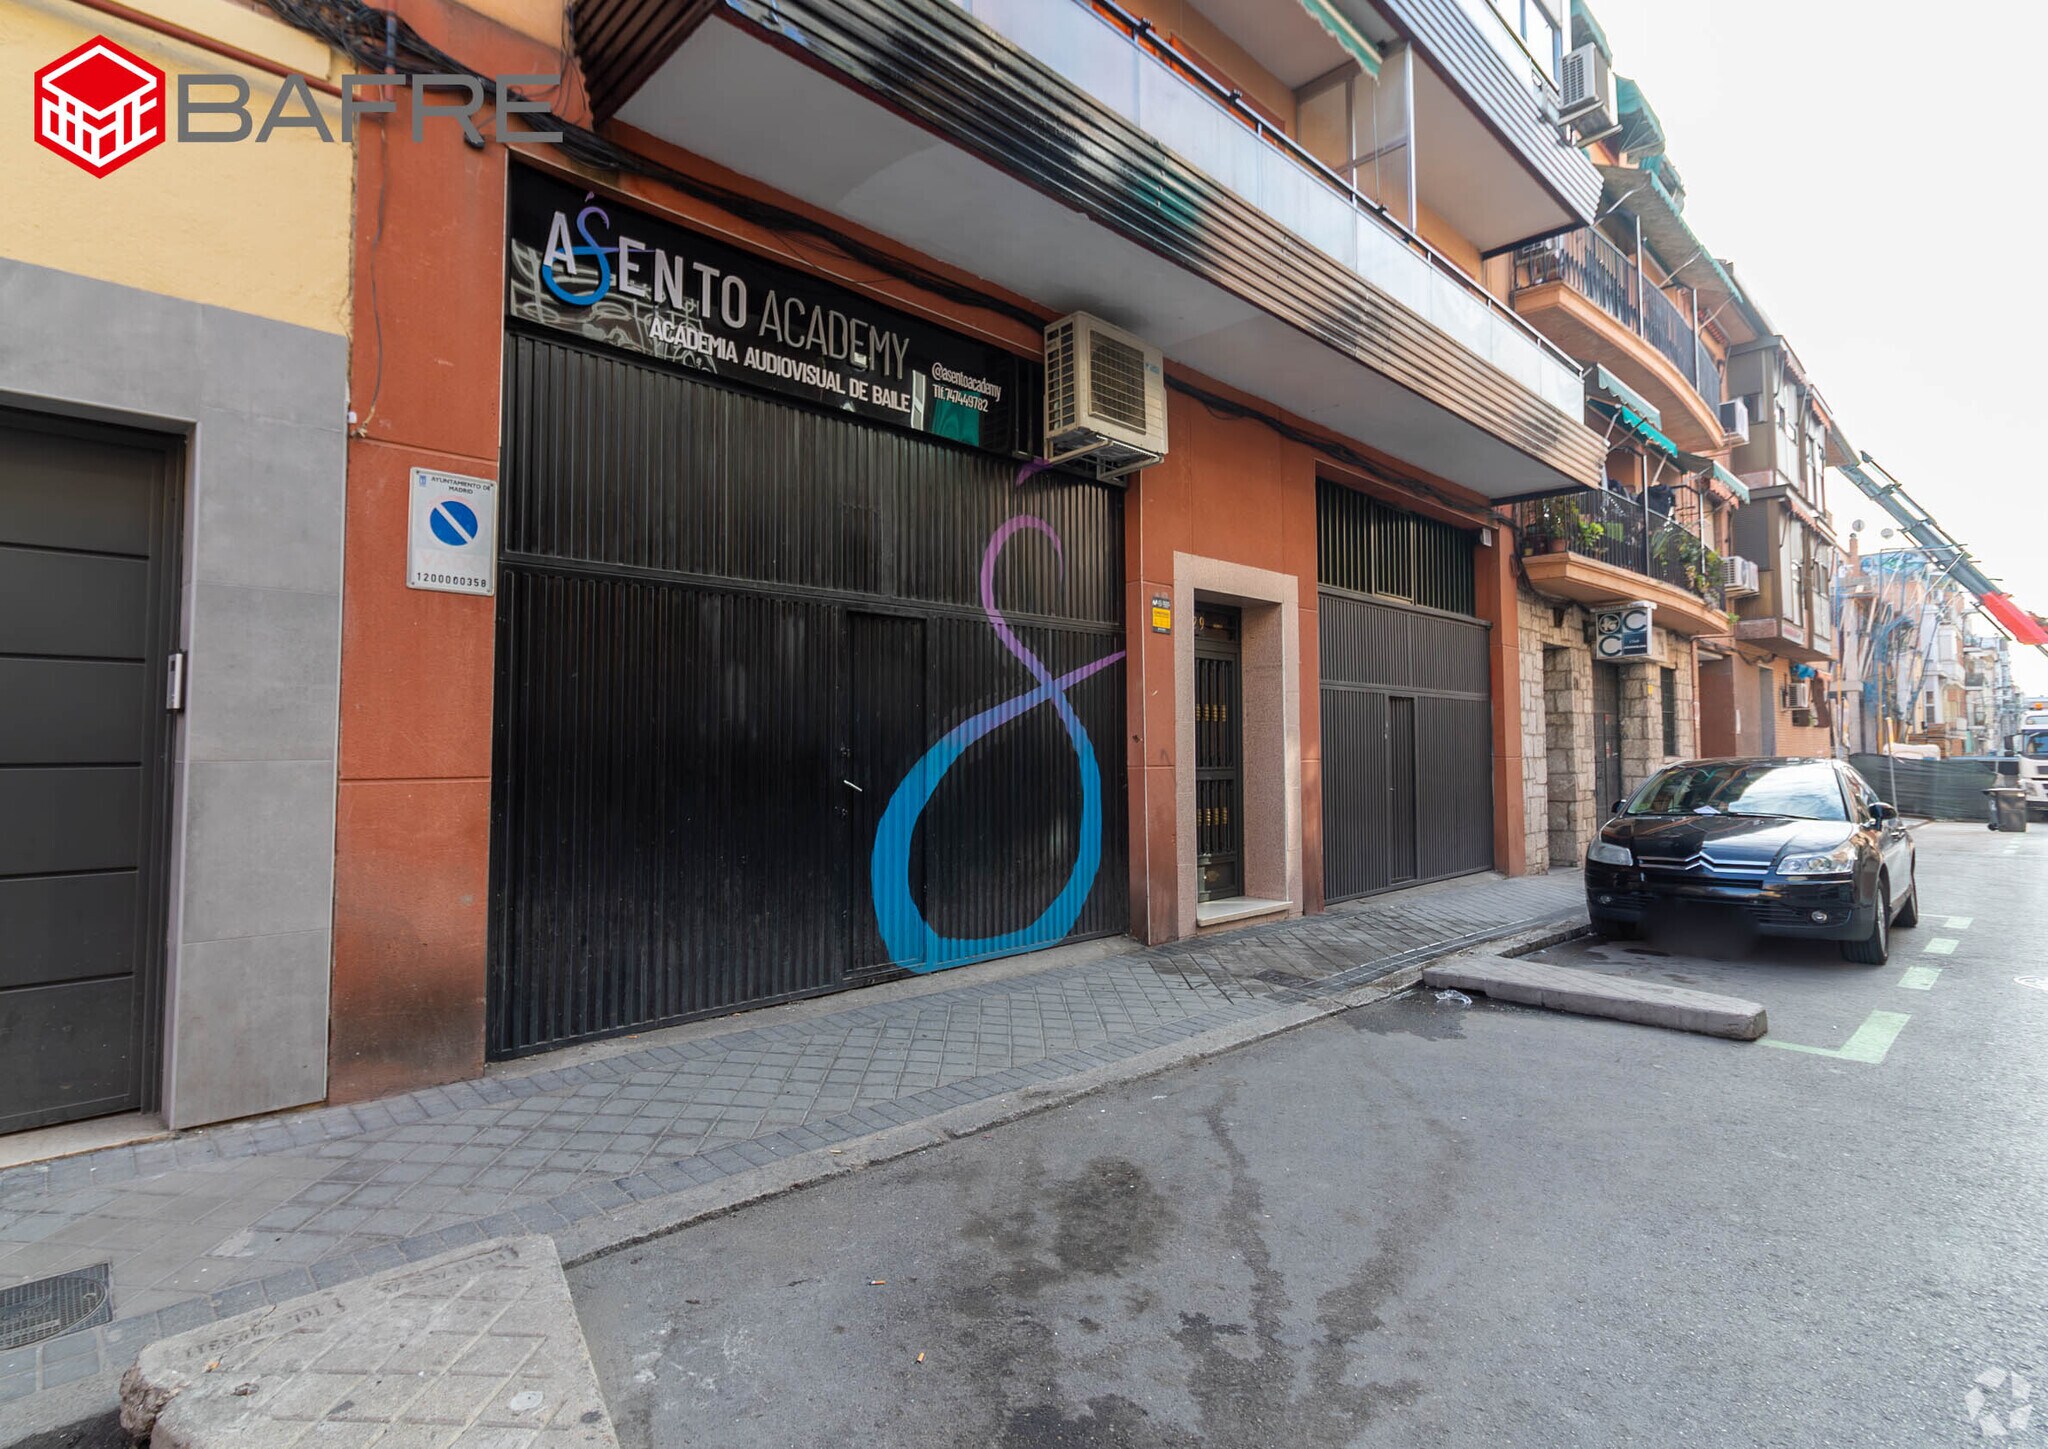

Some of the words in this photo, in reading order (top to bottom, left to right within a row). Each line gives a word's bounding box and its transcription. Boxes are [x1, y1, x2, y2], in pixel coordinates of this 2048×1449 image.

[758, 289, 911, 380] ACADEMY
[648, 312, 739, 366] ACADEMIA
[743, 346, 846, 394] AUDIOVISUAL
[848, 377, 869, 402] DE
[871, 383, 911, 415] BAILE
[931, 361, 1002, 403] @asentoacademy
[430, 476, 482, 489] AYUNTAMIENTO
[448, 485, 474, 495] MADRID
[416, 572, 487, 588] 1200000358
